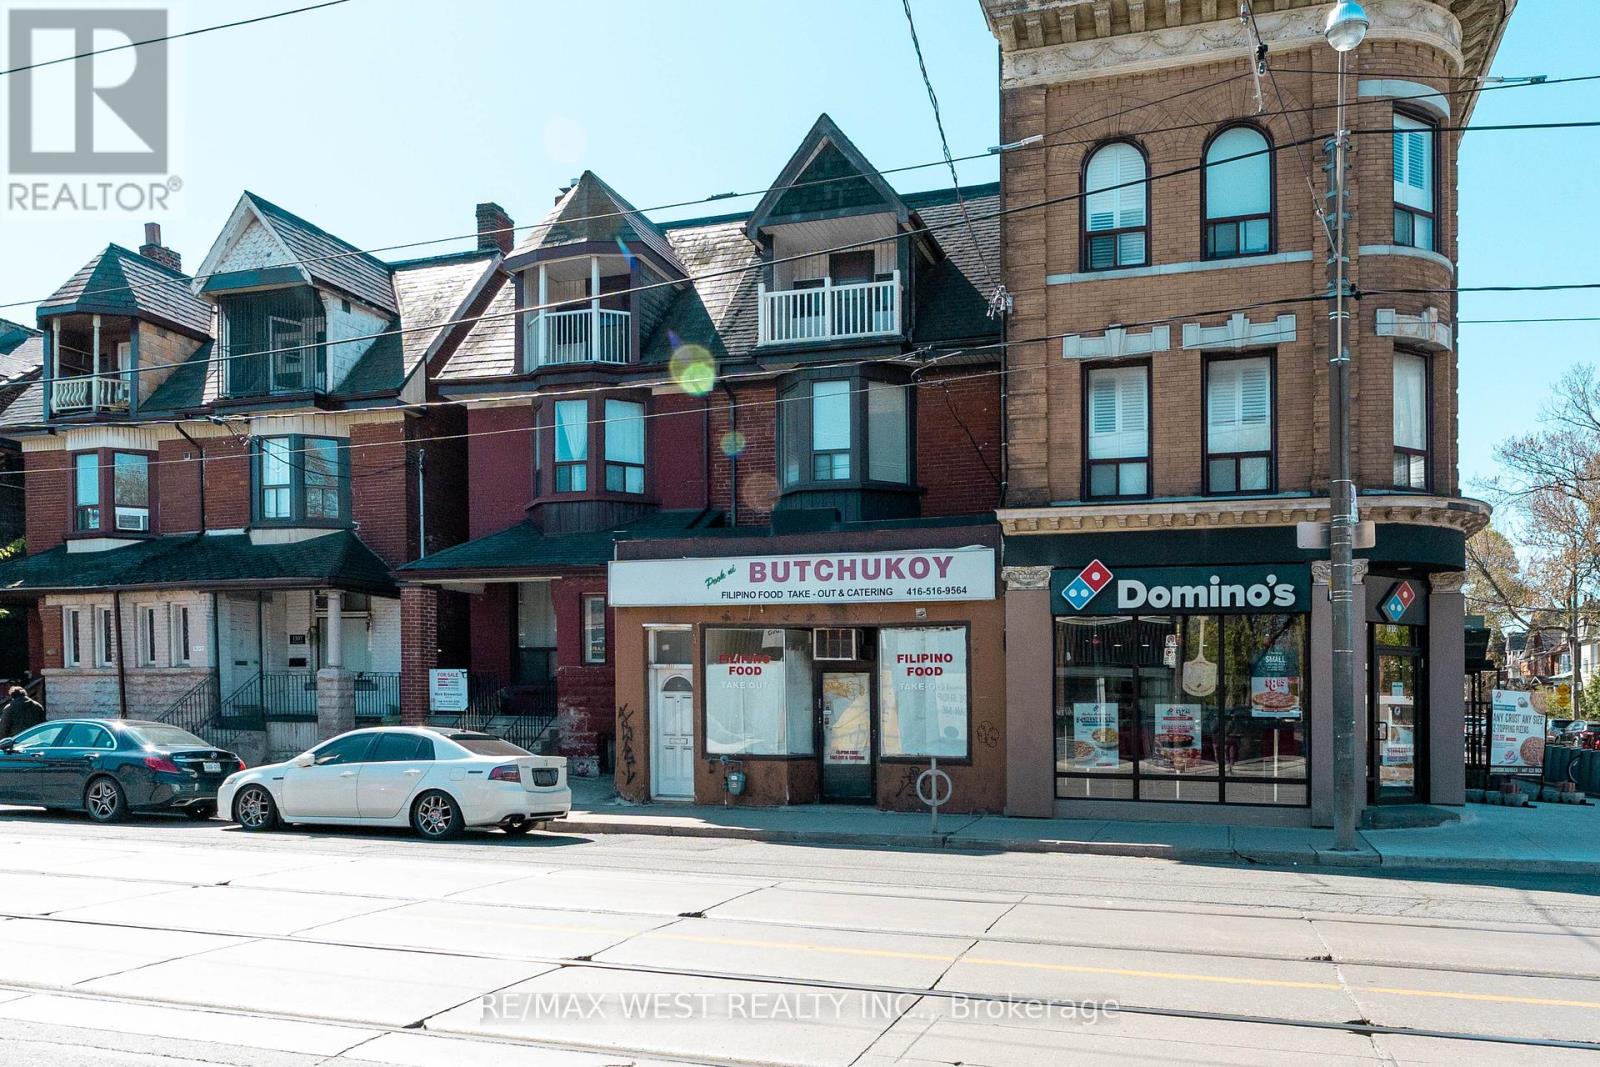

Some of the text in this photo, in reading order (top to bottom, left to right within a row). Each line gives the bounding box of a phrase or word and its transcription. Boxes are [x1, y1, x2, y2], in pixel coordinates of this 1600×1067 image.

[749, 556, 954, 583] BUTCHUKOY
[721, 591, 757, 599] FILIPINO
[758, 590, 783, 598] FOOD
[787, 590, 811, 598] TAKE
[817, 589, 837, 598] OUT
[838, 589, 845, 597] &
[847, 588, 893, 597] CATERING
[906, 586, 967, 596] 416-516-9564
[1117, 573, 1296, 609] Domino's
[897, 653, 953, 664] FILIPINO
[728, 666, 762, 676] FOOD
[907, 667, 943, 677] FOOD
